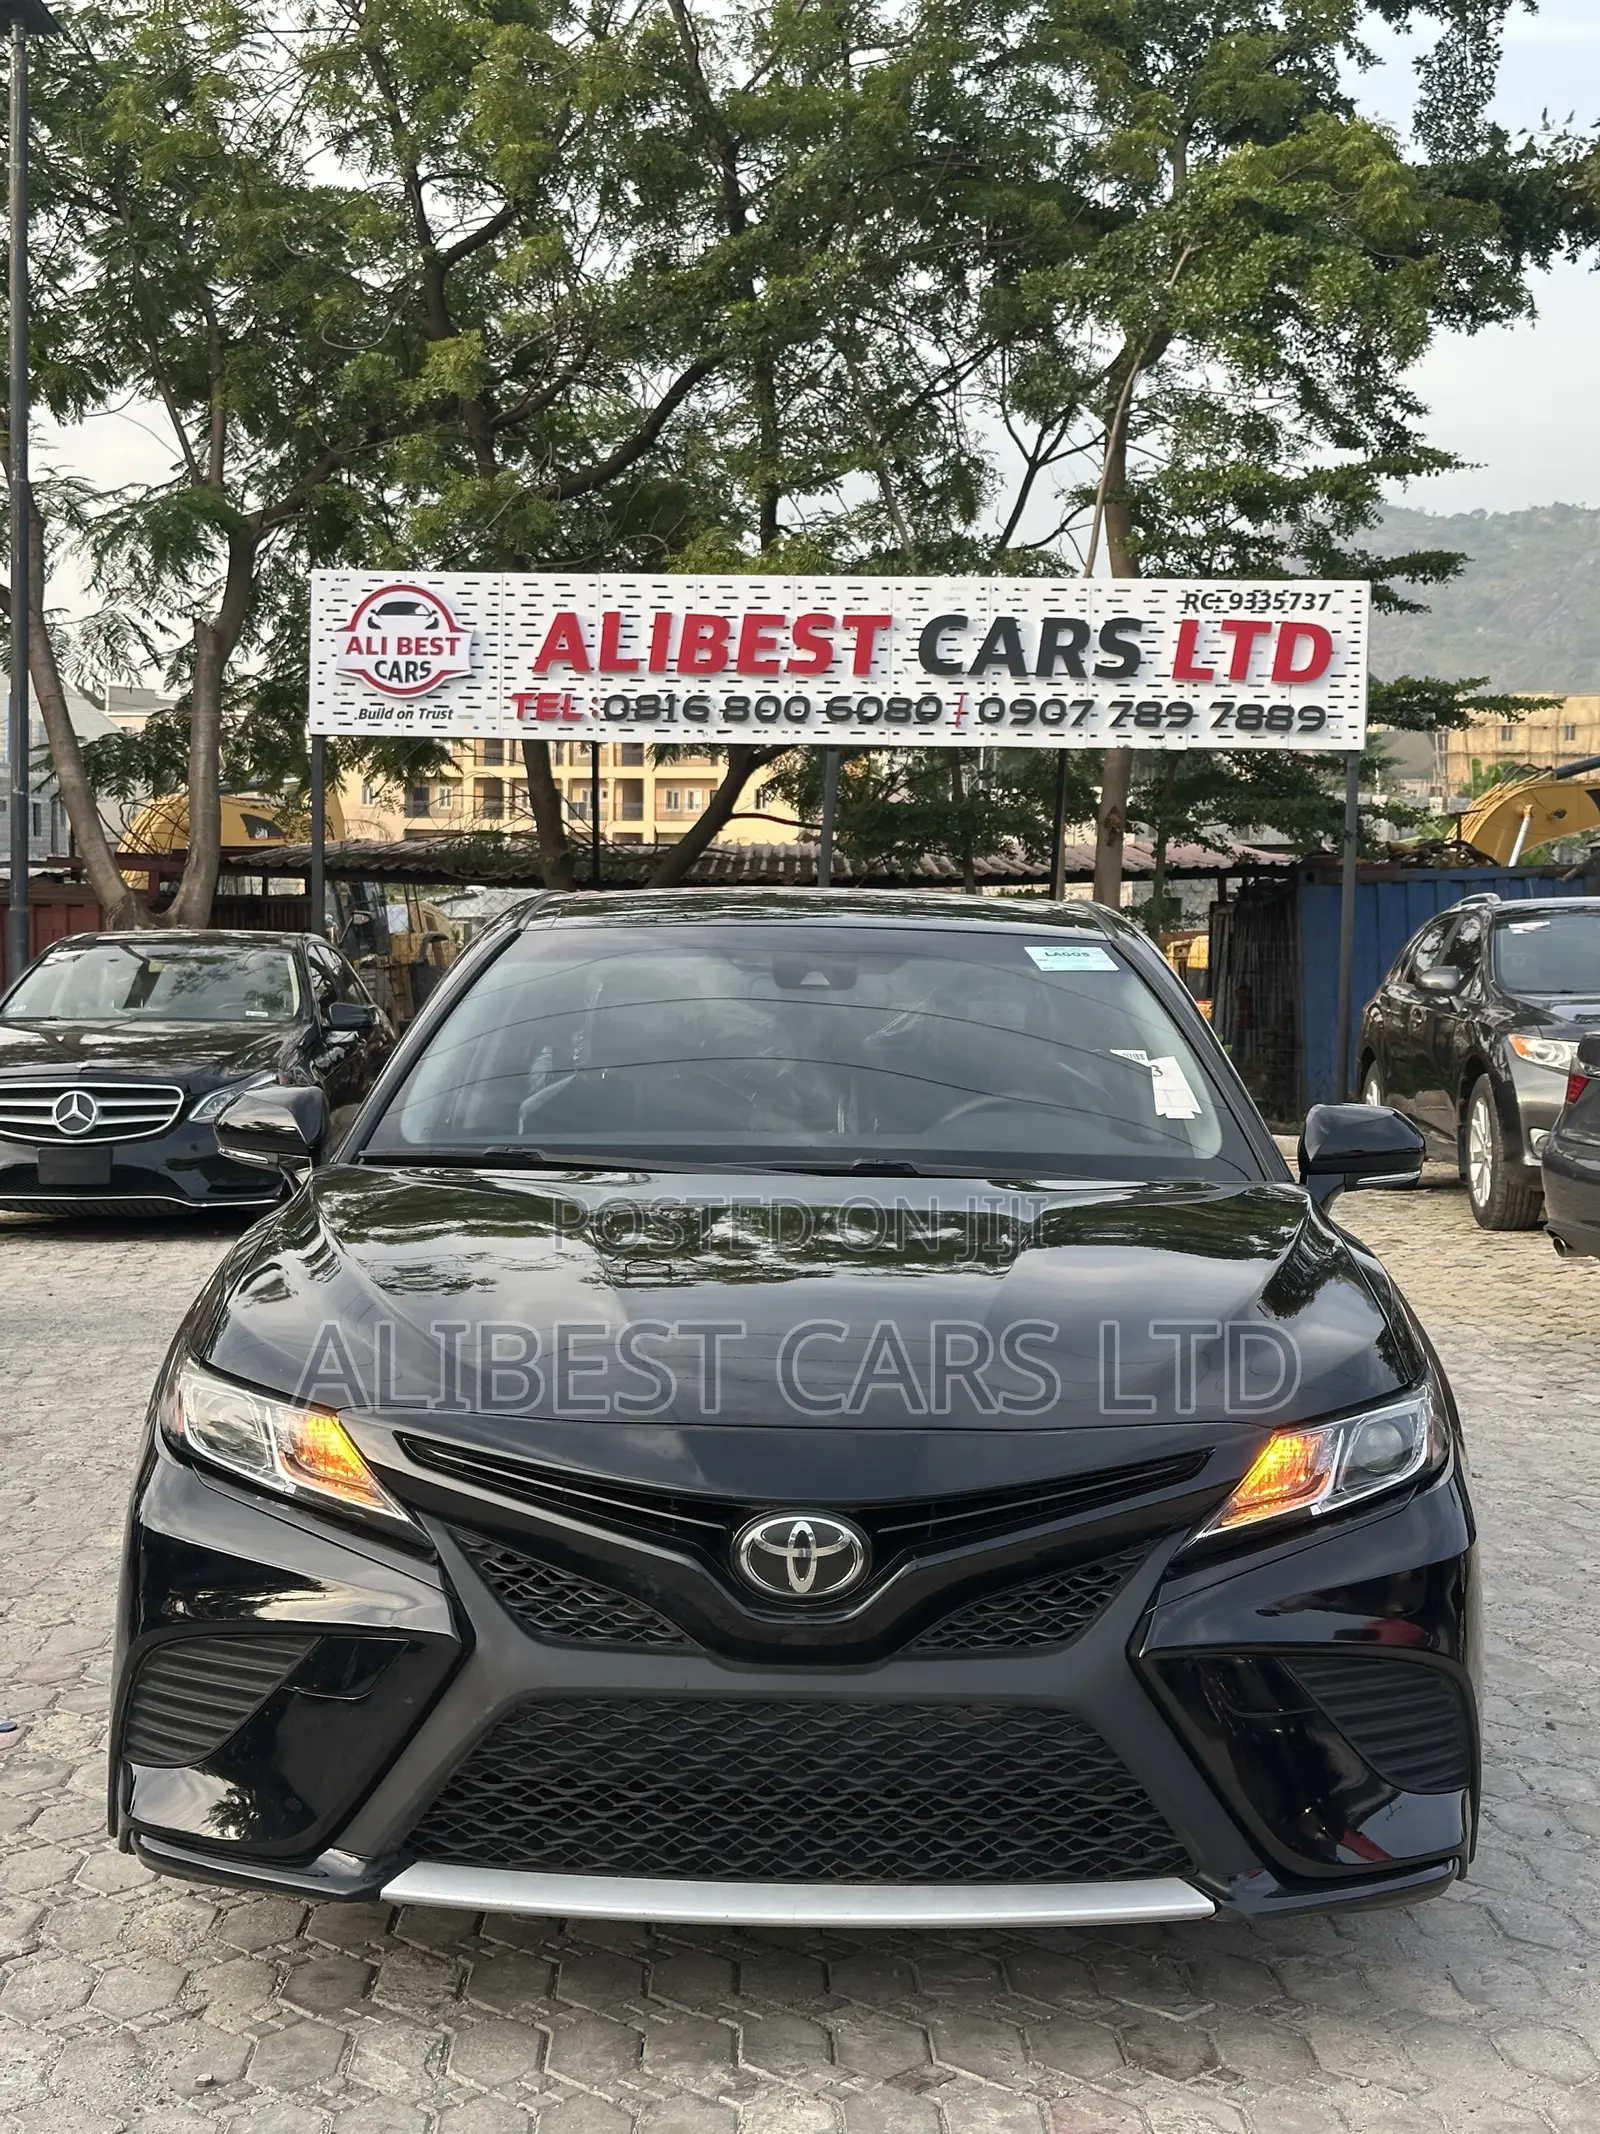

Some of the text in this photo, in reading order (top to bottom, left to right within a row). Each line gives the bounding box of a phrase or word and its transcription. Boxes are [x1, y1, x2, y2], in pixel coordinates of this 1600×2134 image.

[1229, 592, 1332, 611] 9335737
[345, 636, 461, 656] ALI BEST
[532, 611, 1334, 684] ALIBEST CARS LTD
[374, 660, 432, 683] CARS
[359, 707, 454, 720] Build on Trust
[603, 693, 711, 724] 0816
[722, 695, 811, 724] 800
[825, 696, 943, 724] 6080
[978, 697, 1095, 727] 0907
[1109, 700, 1195, 729] 789
[1209, 702, 1328, 733] 7889
